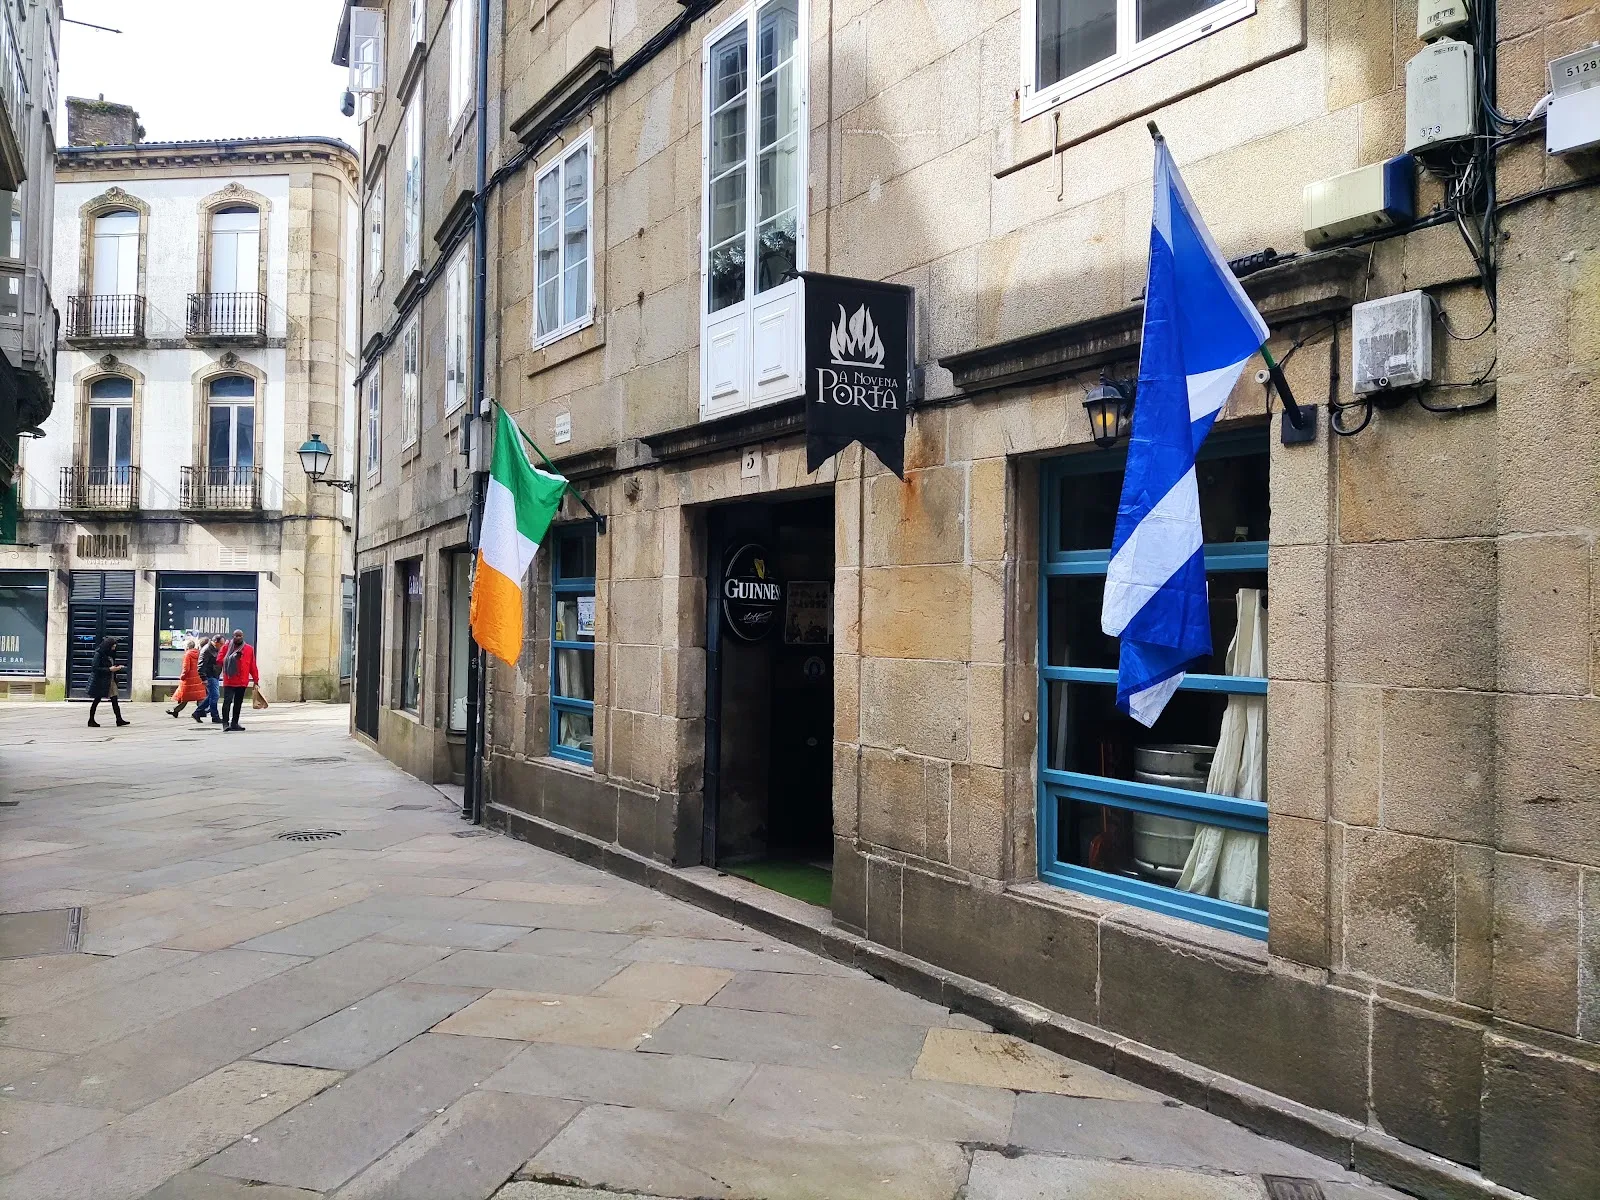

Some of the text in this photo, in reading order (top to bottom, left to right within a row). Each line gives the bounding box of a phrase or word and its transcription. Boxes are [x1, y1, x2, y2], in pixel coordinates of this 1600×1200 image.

[1567, 59, 1600, 77] 5128
[1420, 125, 1441, 138] 373
[854, 371, 898, 388] NOVENA
[815, 367, 899, 412] PORTA
[76, 534, 128, 558] MAMBARA
[725, 578, 782, 601] GUINNES
[193, 617, 230, 634] MAMBARA
[0, 635, 20, 652] BARA
